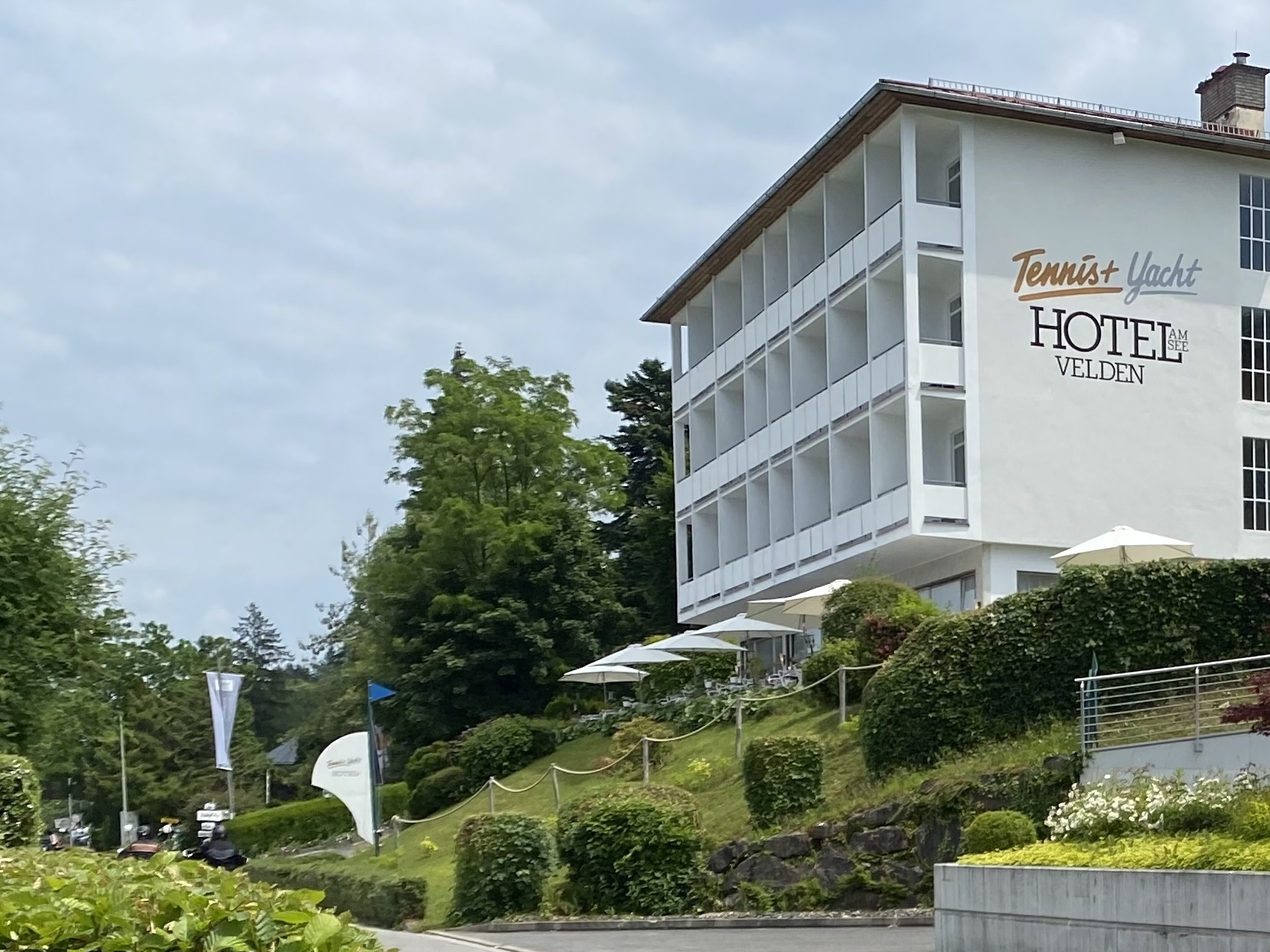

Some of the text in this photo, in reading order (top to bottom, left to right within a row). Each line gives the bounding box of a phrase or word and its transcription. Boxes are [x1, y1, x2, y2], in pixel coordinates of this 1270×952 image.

[1124, 251, 1202, 305] Yacht
[1030, 306, 1183, 363] HOTEL
[1167, 340, 1189, 352] SEE
[1168, 329, 1189, 340] AM
[1055, 355, 1145, 384] VELDEN
